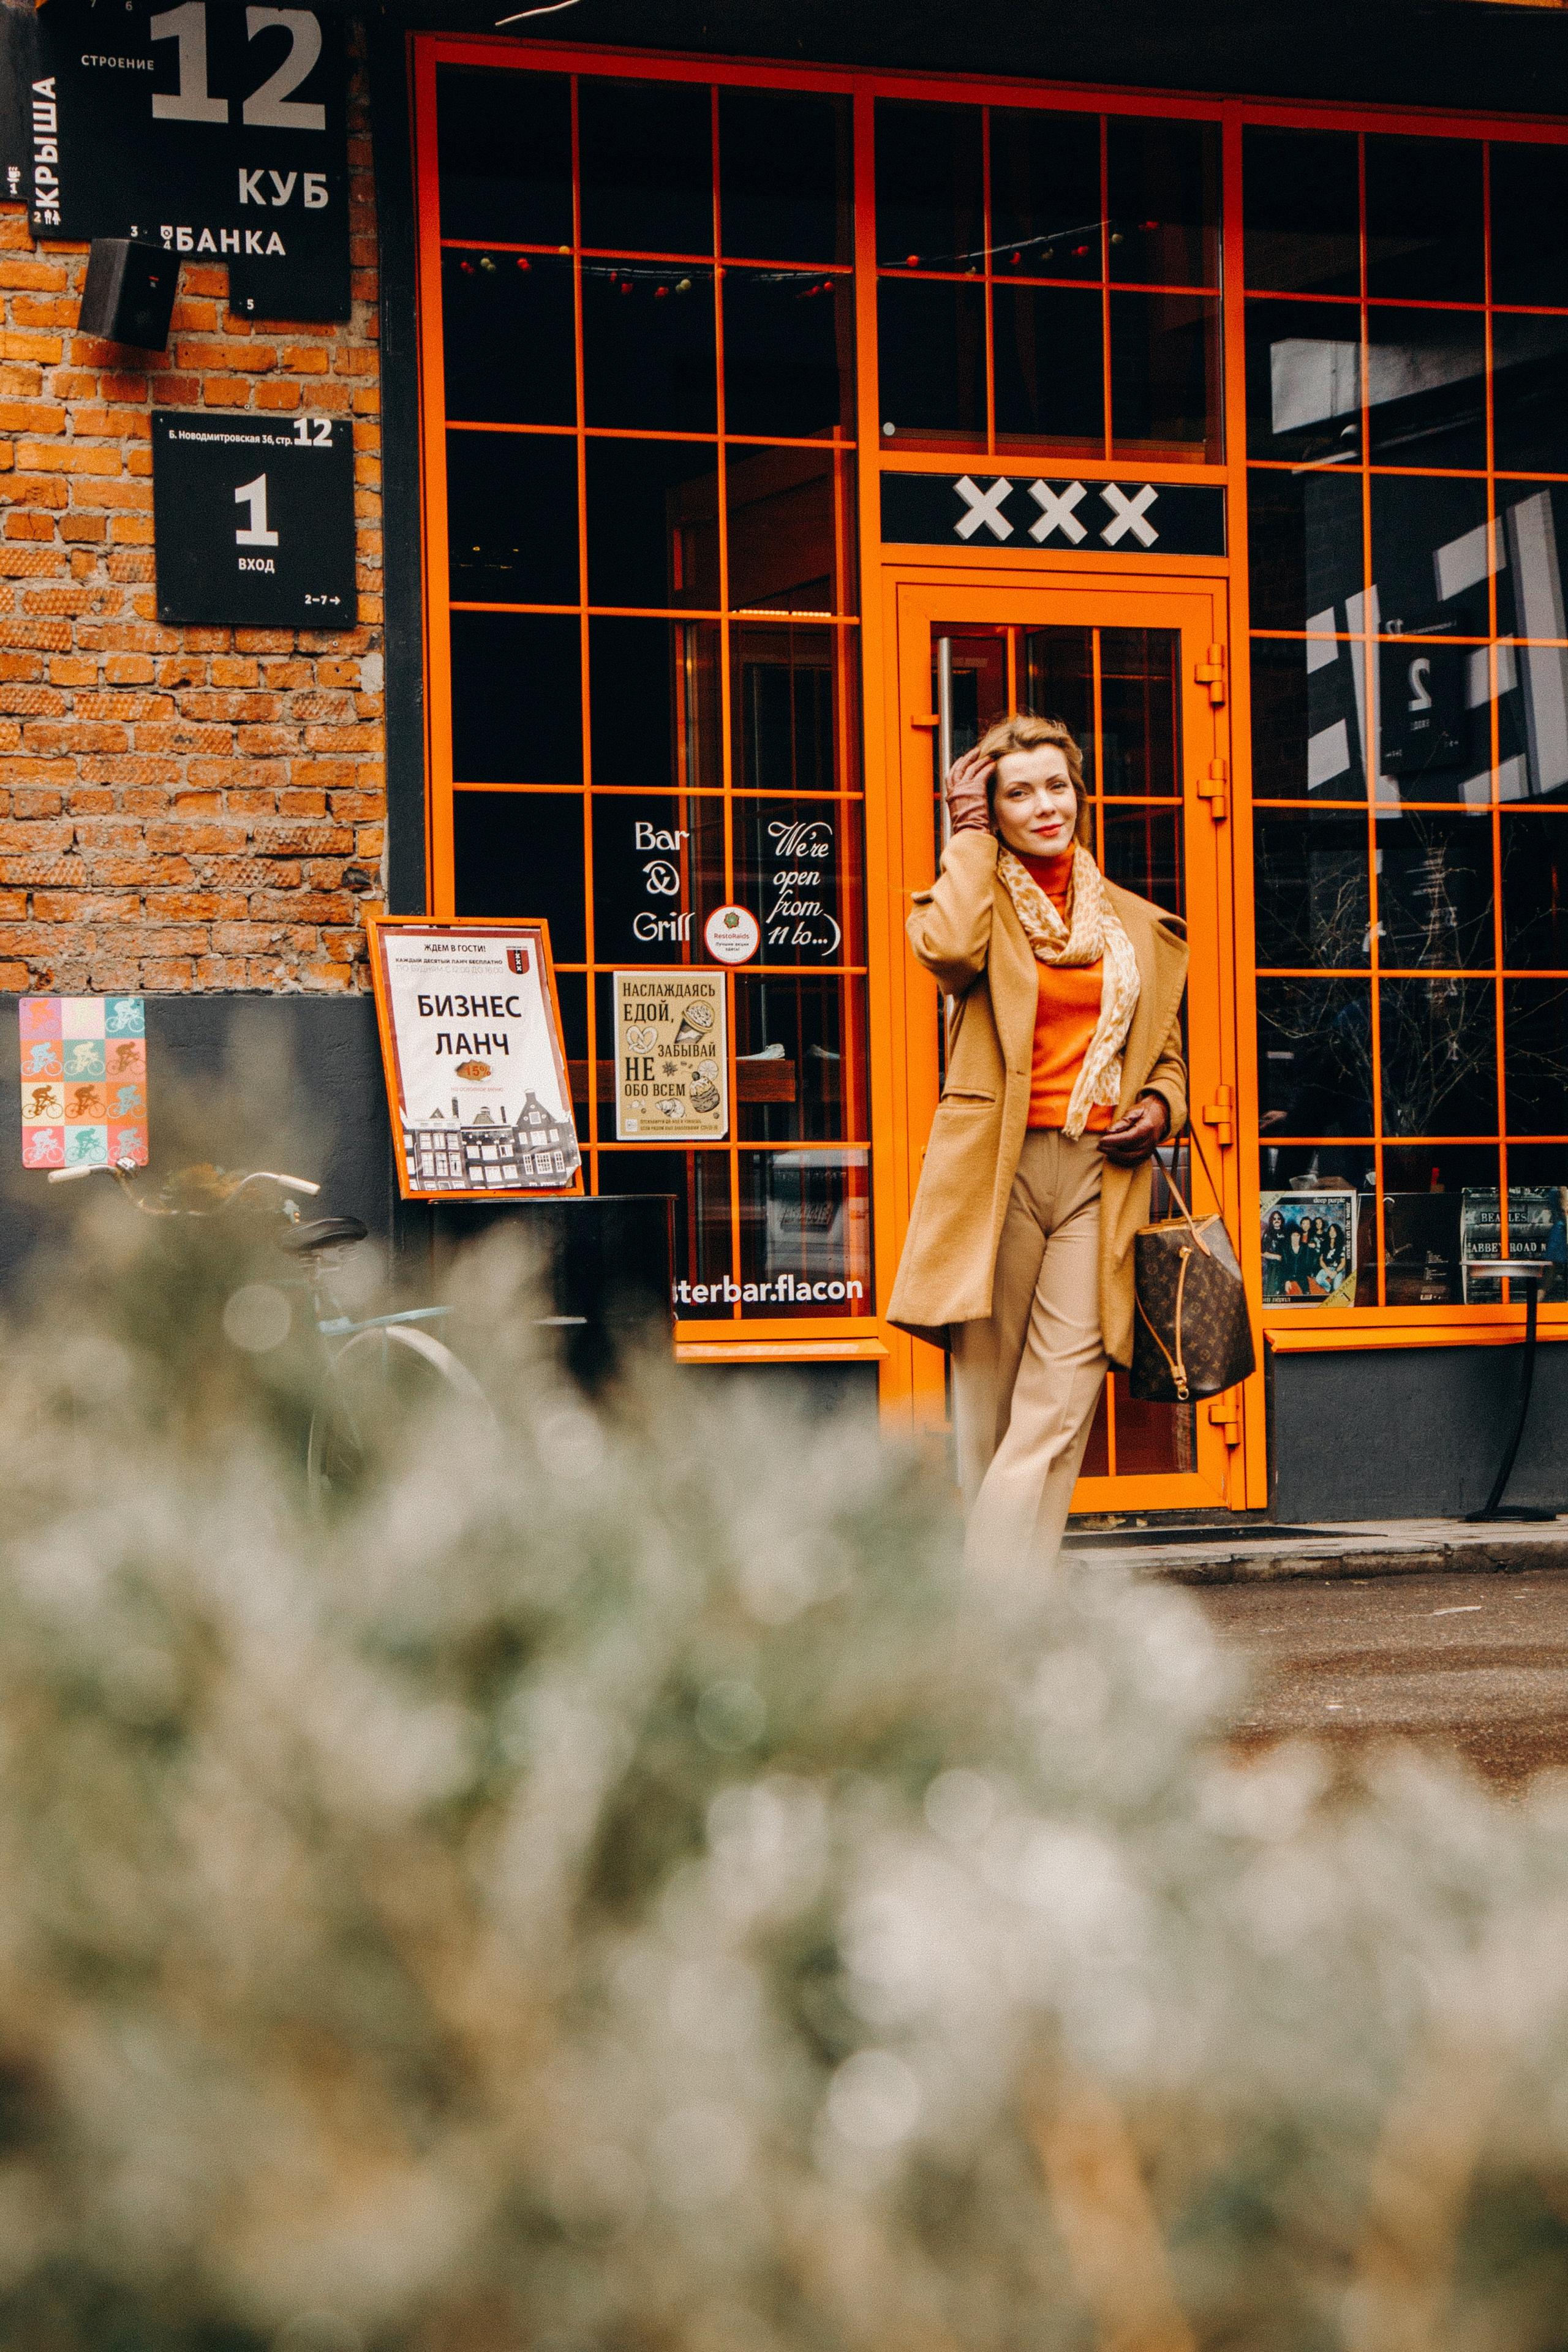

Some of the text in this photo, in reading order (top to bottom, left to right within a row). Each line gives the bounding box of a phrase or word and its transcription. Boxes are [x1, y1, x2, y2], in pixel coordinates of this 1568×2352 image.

[81, 2, 325, 130] СТРОЕНИЕ 12
[32, 77, 59, 208] КРЫША
[238, 168, 329, 208] КУБ
[34, 211, 42, 223] 2
[130, 225, 138, 238] 3
[176, 227, 286, 255] БАНКА
[247, 298, 254, 310] 5
[169, 418, 333, 447] Б. Новодмитровская 36, стр. 12
[235, 473, 279, 546] 1
[238, 558, 275, 574] ВХОД
[635, 822, 690, 851] Bar
[768, 821, 833, 858] We're
[643, 861, 680, 895] &
[773, 871, 821, 894] open
[766, 889, 823, 924] from
[633, 911, 695, 941] Grill
[768, 926, 790, 944] 11
[424, 944, 449, 953] ЖДЕМ
[623, 982, 715, 998] НАСЛАЖДАЯСЬ
[417, 995, 521, 1018] БИЗНЕС
[624, 1000, 674, 1023] ЕДОЙ,
[435, 1033, 510, 1055] ЛАНЧ
[658, 1042, 716, 1057] ЗАБЫВАЙ
[464, 1065, 491, 1076] 15%
[625, 1057, 655, 1081] НЕ
[625, 1084, 685, 1096] ОБО ВСЕМ
[1481, 1212, 1528, 1223] BEALES
[1509, 1242, 1537, 1252] ROAD
